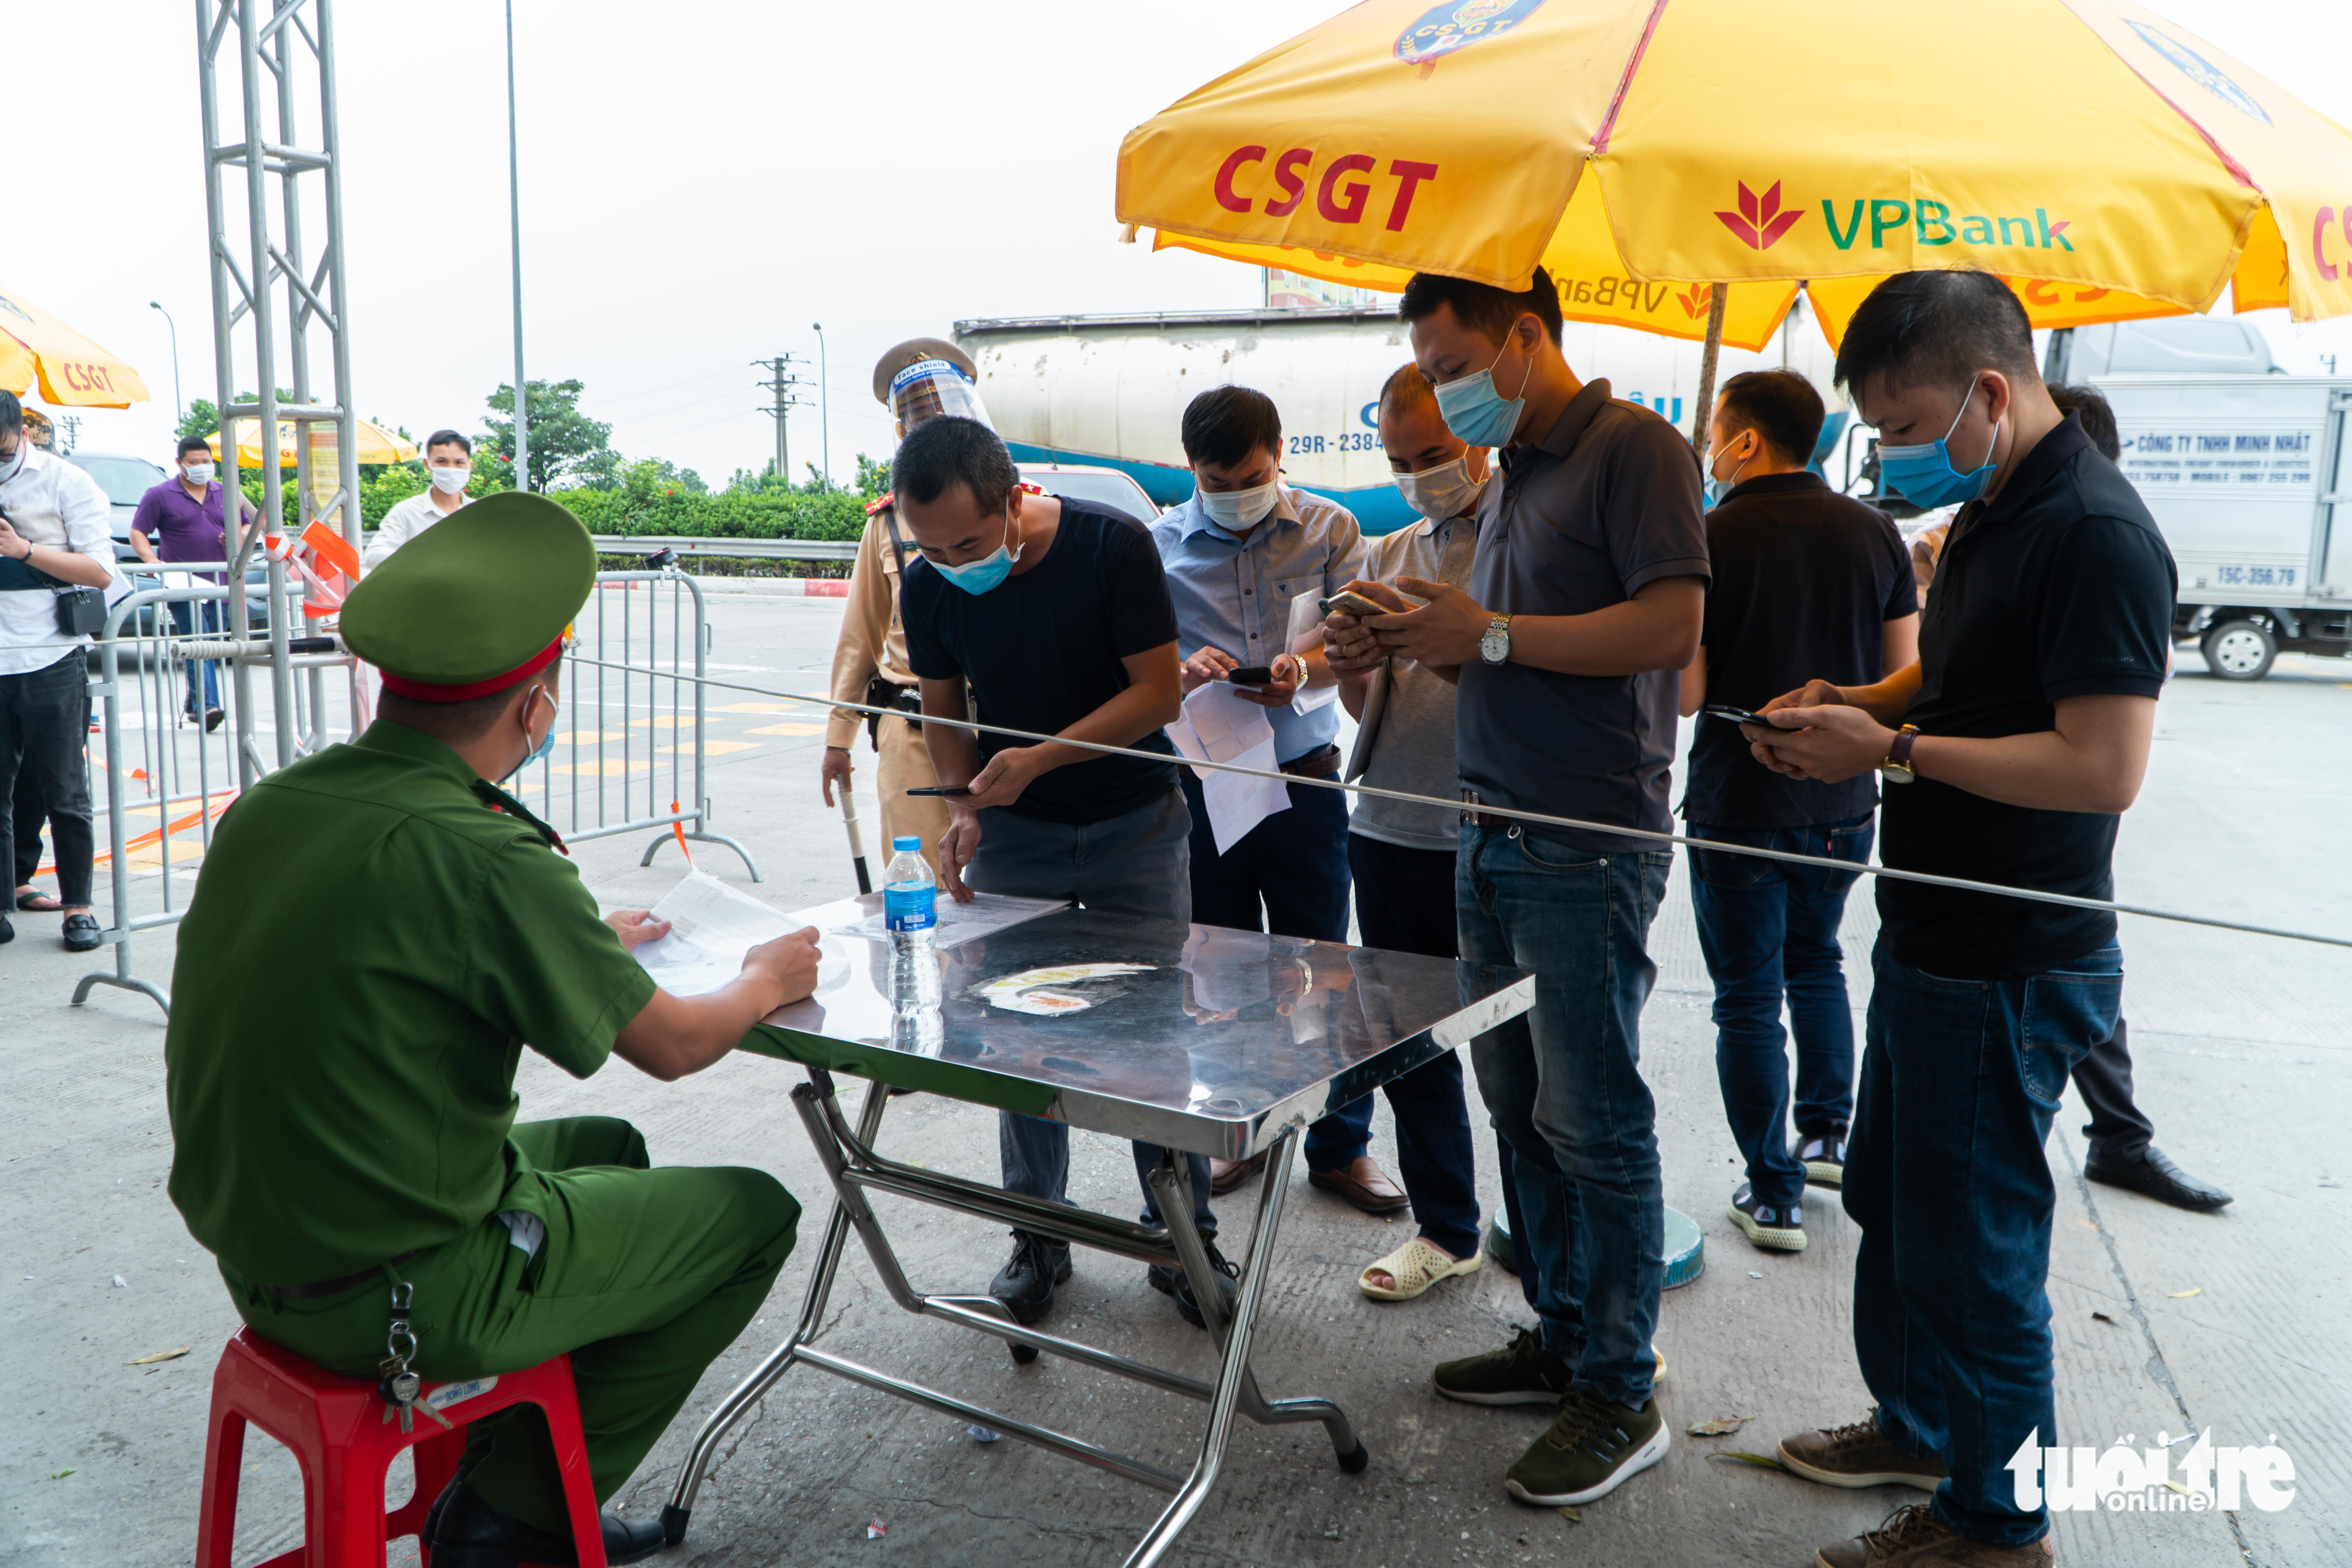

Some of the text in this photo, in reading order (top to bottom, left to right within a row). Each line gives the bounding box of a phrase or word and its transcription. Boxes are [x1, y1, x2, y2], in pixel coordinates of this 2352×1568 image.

[1415, 20, 1513, 37] CSGT
[1214, 145, 1438, 232] CSGT
[1821, 199, 2074, 252] VPBank
[64, 363, 114, 392] CSGT
[898, 367, 916, 380] Face
[2138, 433, 2173, 452] CÔNG
[2178, 436, 2191, 452] TY
[2196, 436, 2230, 452] TNHH
[2234, 436, 2270, 452] MINH
[2218, 566, 2295, 586] 15C-356.79
